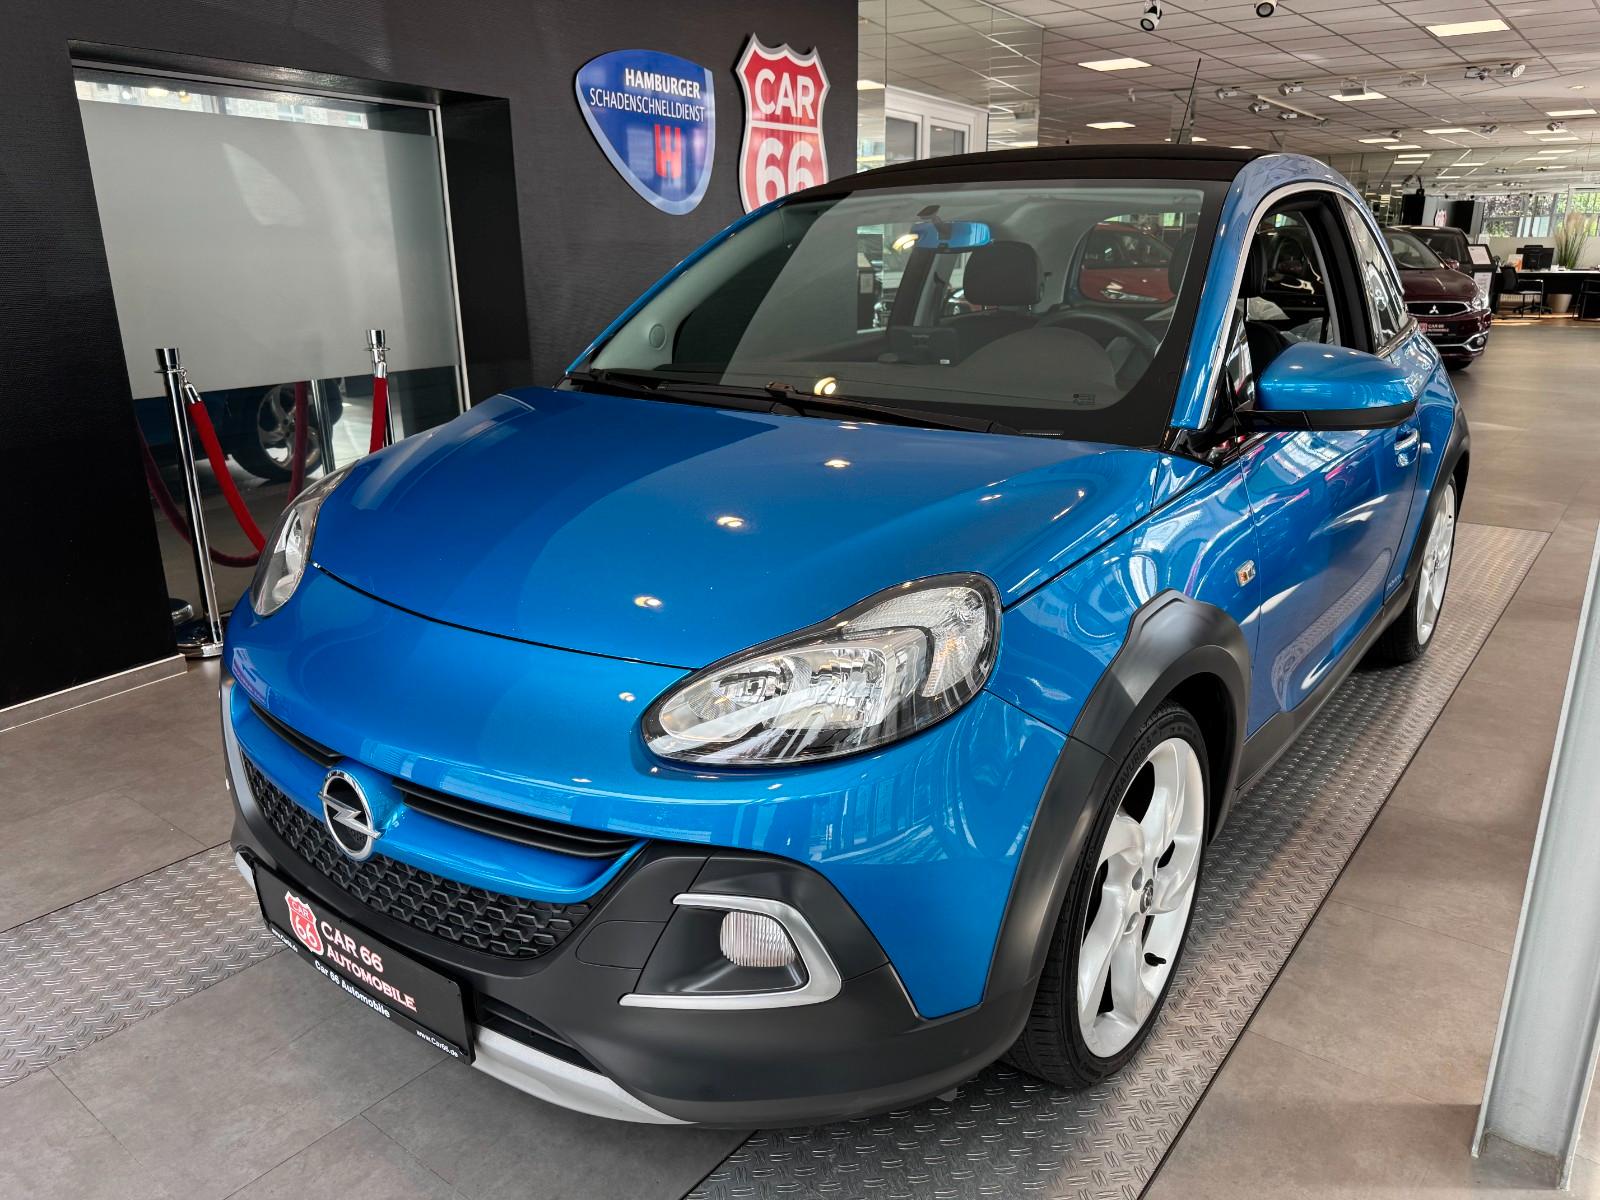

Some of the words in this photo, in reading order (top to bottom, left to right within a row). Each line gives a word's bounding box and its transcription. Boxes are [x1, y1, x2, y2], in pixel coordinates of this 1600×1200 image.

[590, 87, 705, 122] SCHADENSCHNELLDIENST
[625, 68, 701, 99] HAMBURGER
[755, 68, 815, 120] CAR
[755, 137, 814, 203] 66
[291, 901, 310, 920] CAR
[295, 915, 318, 948] 66
[320, 920, 360, 958] CAR
[359, 945, 384, 973] 66
[314, 960, 330, 976] Car
[341, 979, 391, 1018] Automobile
[326, 944, 418, 1013] AUTOMOBILE
